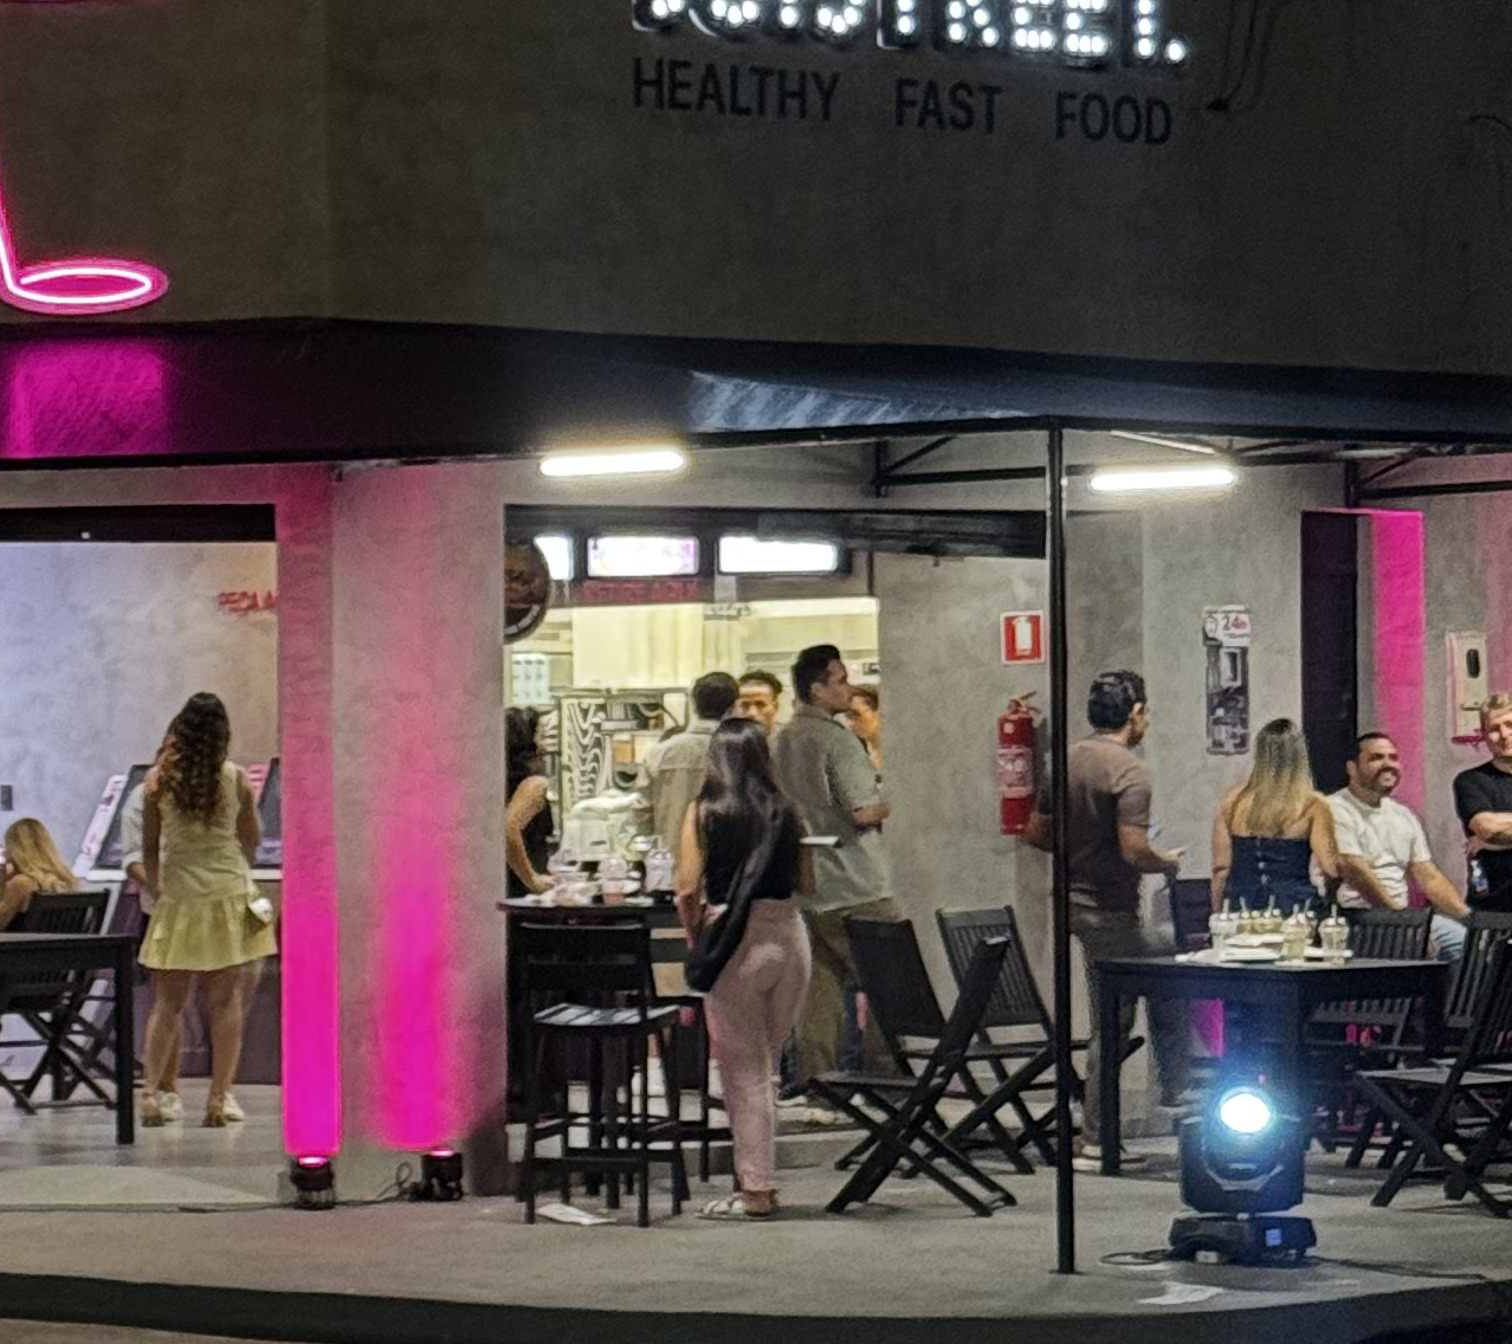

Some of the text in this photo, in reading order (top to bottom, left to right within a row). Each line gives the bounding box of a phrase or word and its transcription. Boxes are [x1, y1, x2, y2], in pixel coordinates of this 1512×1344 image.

[632, 57, 1172, 146] HEALTHY FAST FOOD
